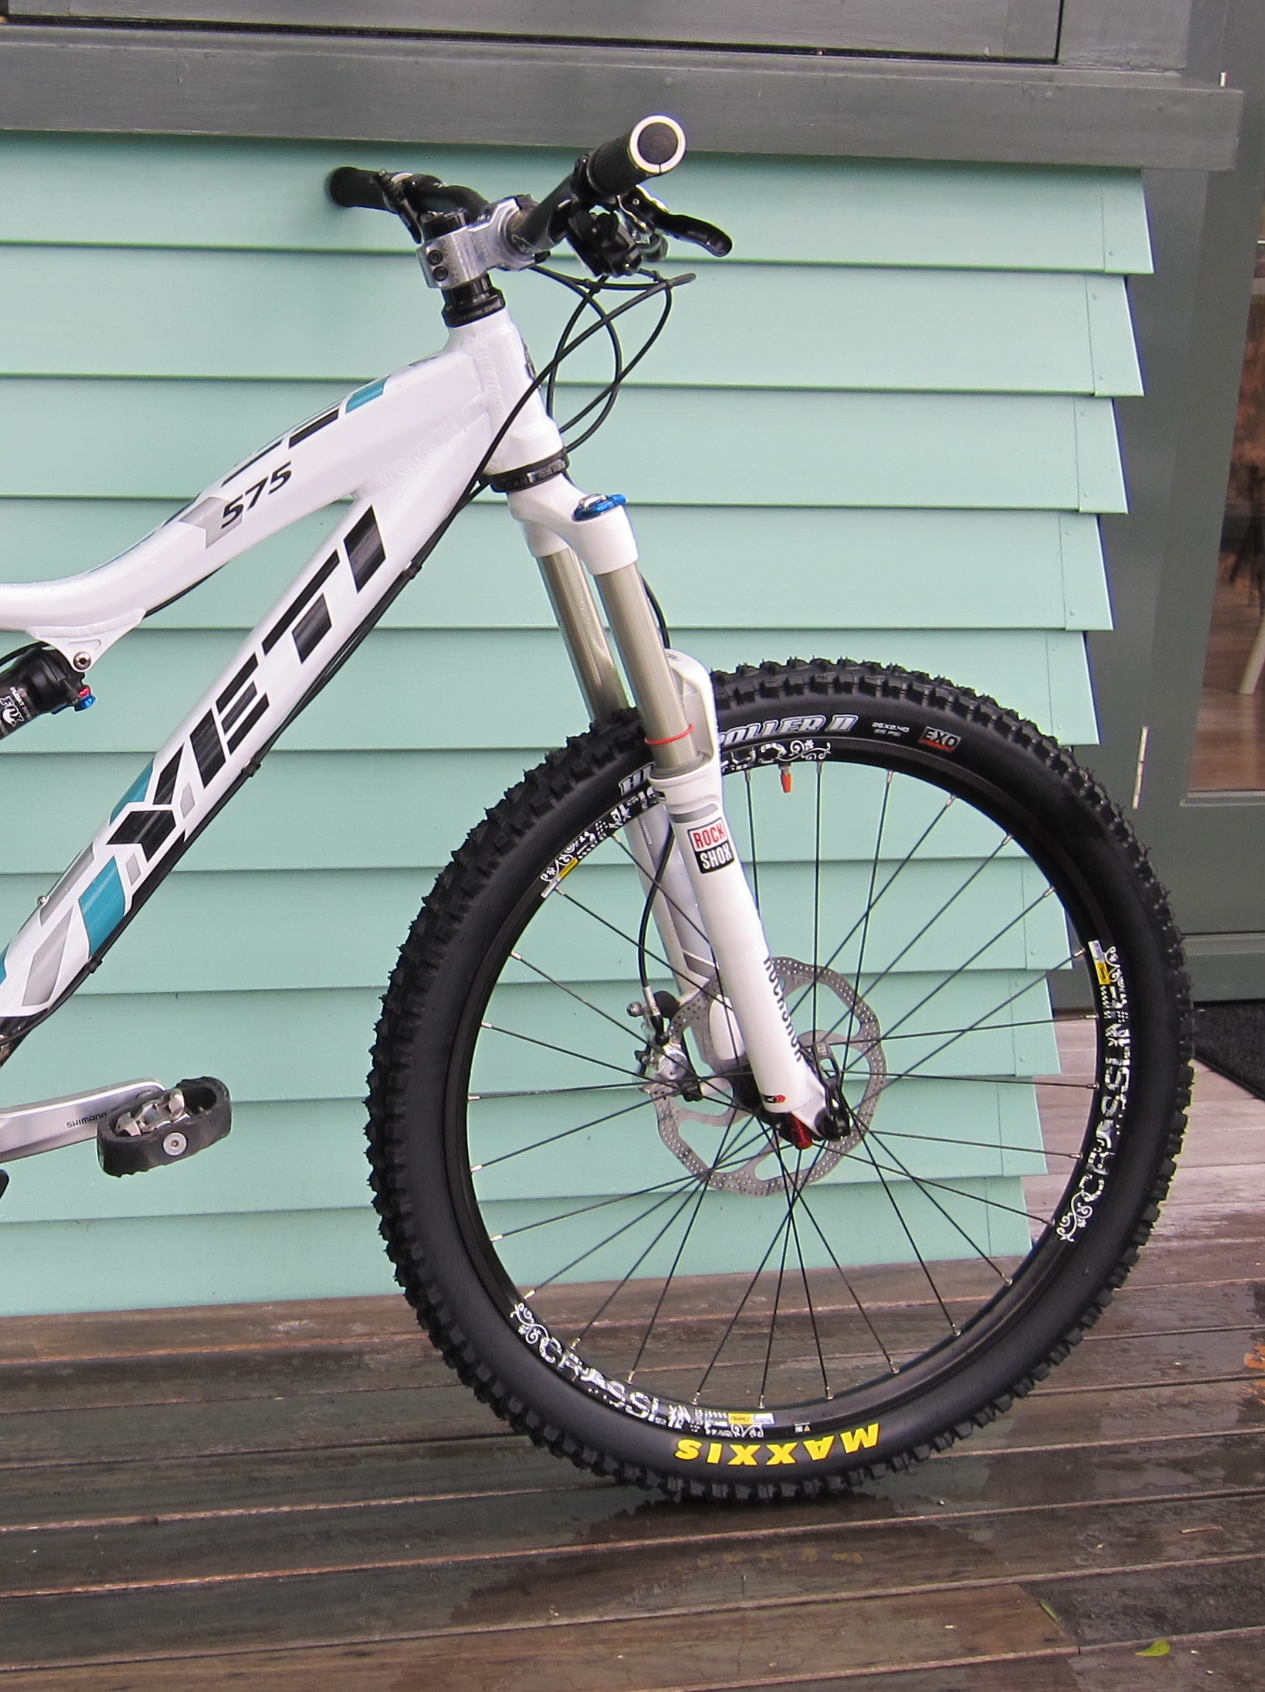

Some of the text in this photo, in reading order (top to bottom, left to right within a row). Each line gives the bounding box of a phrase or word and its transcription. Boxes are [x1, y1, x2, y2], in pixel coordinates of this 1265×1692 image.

[219, 459, 293, 530] 575
[108, 504, 388, 864] YETI
[925, 727, 958, 748] EXO
[692, 822, 726, 849] ROCK
[699, 842, 733, 870] SHOX
[675, 1423, 880, 1467] MAXXIS
